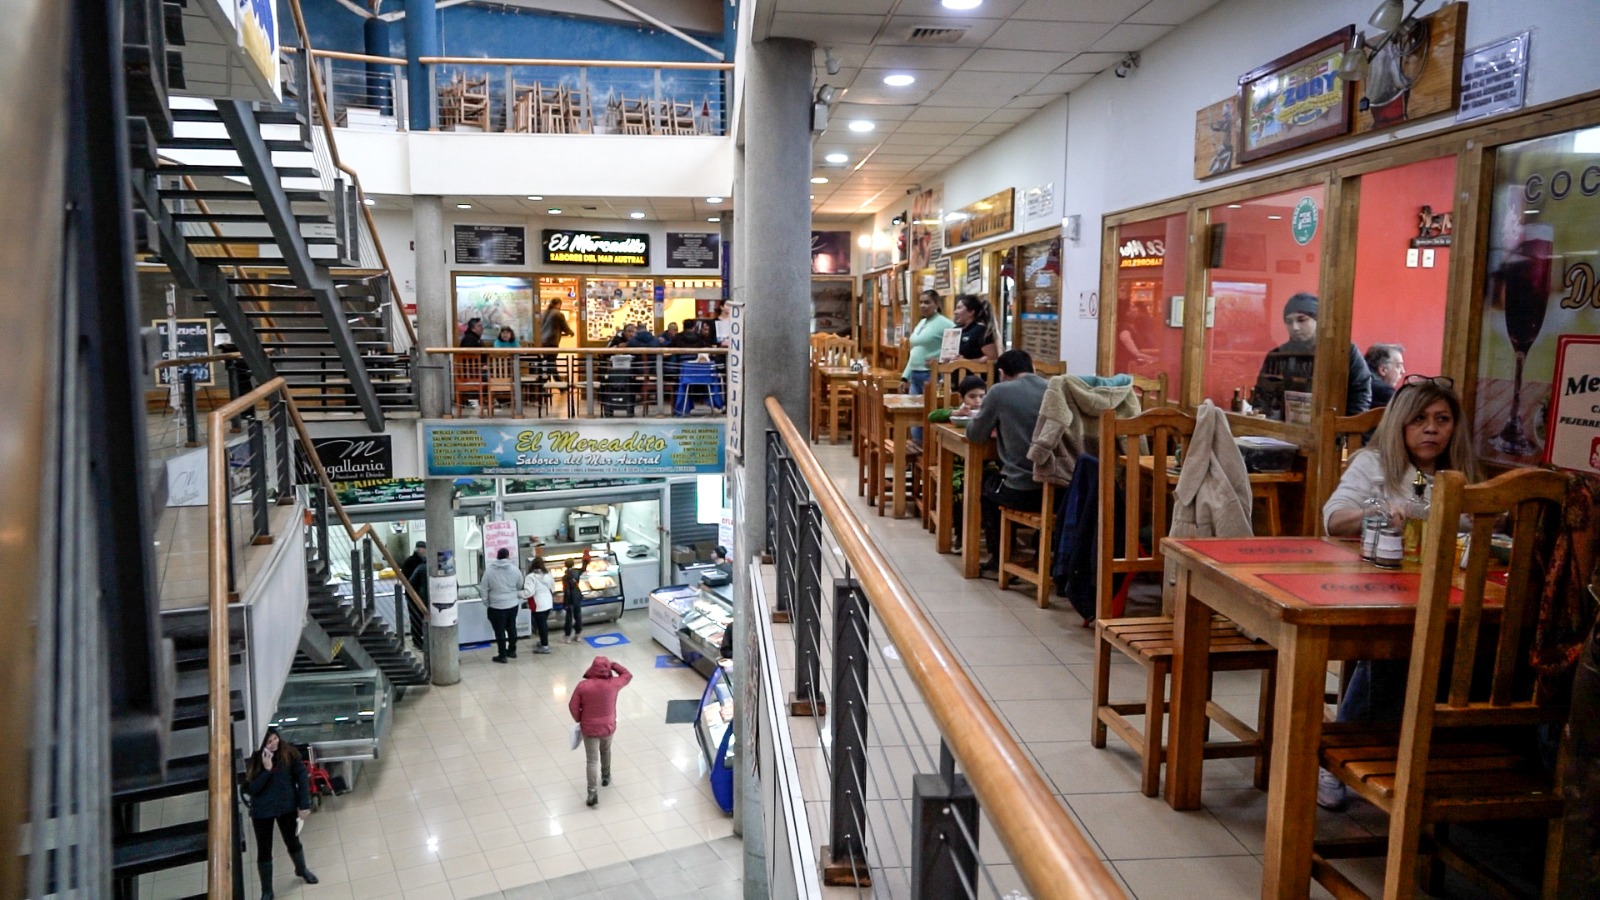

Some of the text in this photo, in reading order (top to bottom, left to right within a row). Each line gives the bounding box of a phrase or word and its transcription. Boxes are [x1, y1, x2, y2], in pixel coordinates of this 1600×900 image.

[548, 233, 646, 254] El Mercadito
[550, 253, 645, 264] SABORES DEL MAR AUSTRAL
[730, 306, 740, 450] DONDE JUAN
[1565, 374, 1600, 396] Me
[515, 429, 668, 453] El Mercadito
[302, 459, 386, 480] Mgallania
[515, 454, 661, 466] Sabores del Mar Austral
